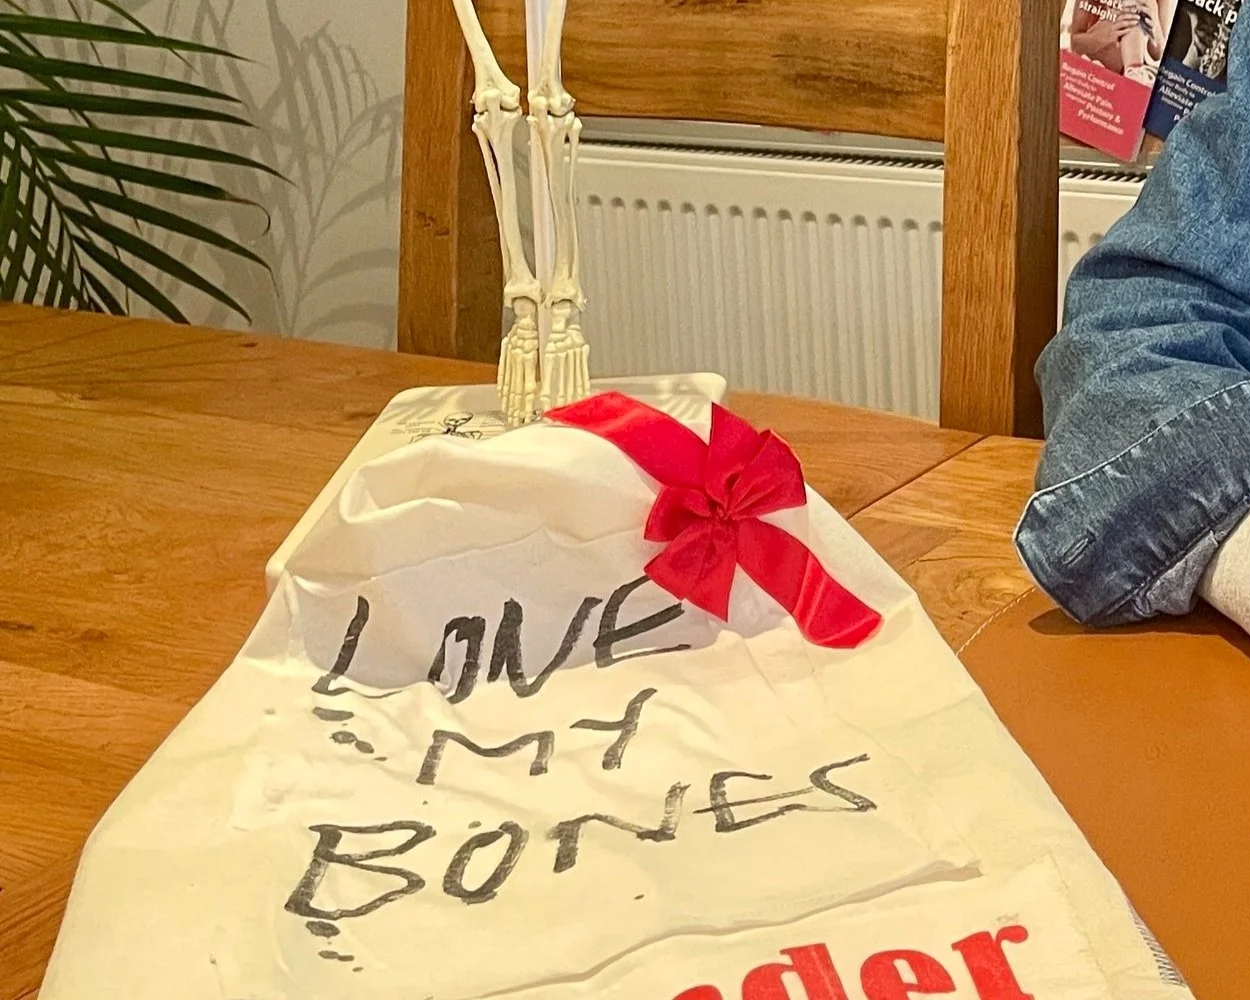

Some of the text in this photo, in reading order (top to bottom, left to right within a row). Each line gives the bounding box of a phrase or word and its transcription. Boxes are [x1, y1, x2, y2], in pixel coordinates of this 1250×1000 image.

[1079, 1, 1117, 22] straight
[415, 687, 658, 785] MY
[284, 753, 878, 920] BONES
[670, 924, 1035, 1000] der
